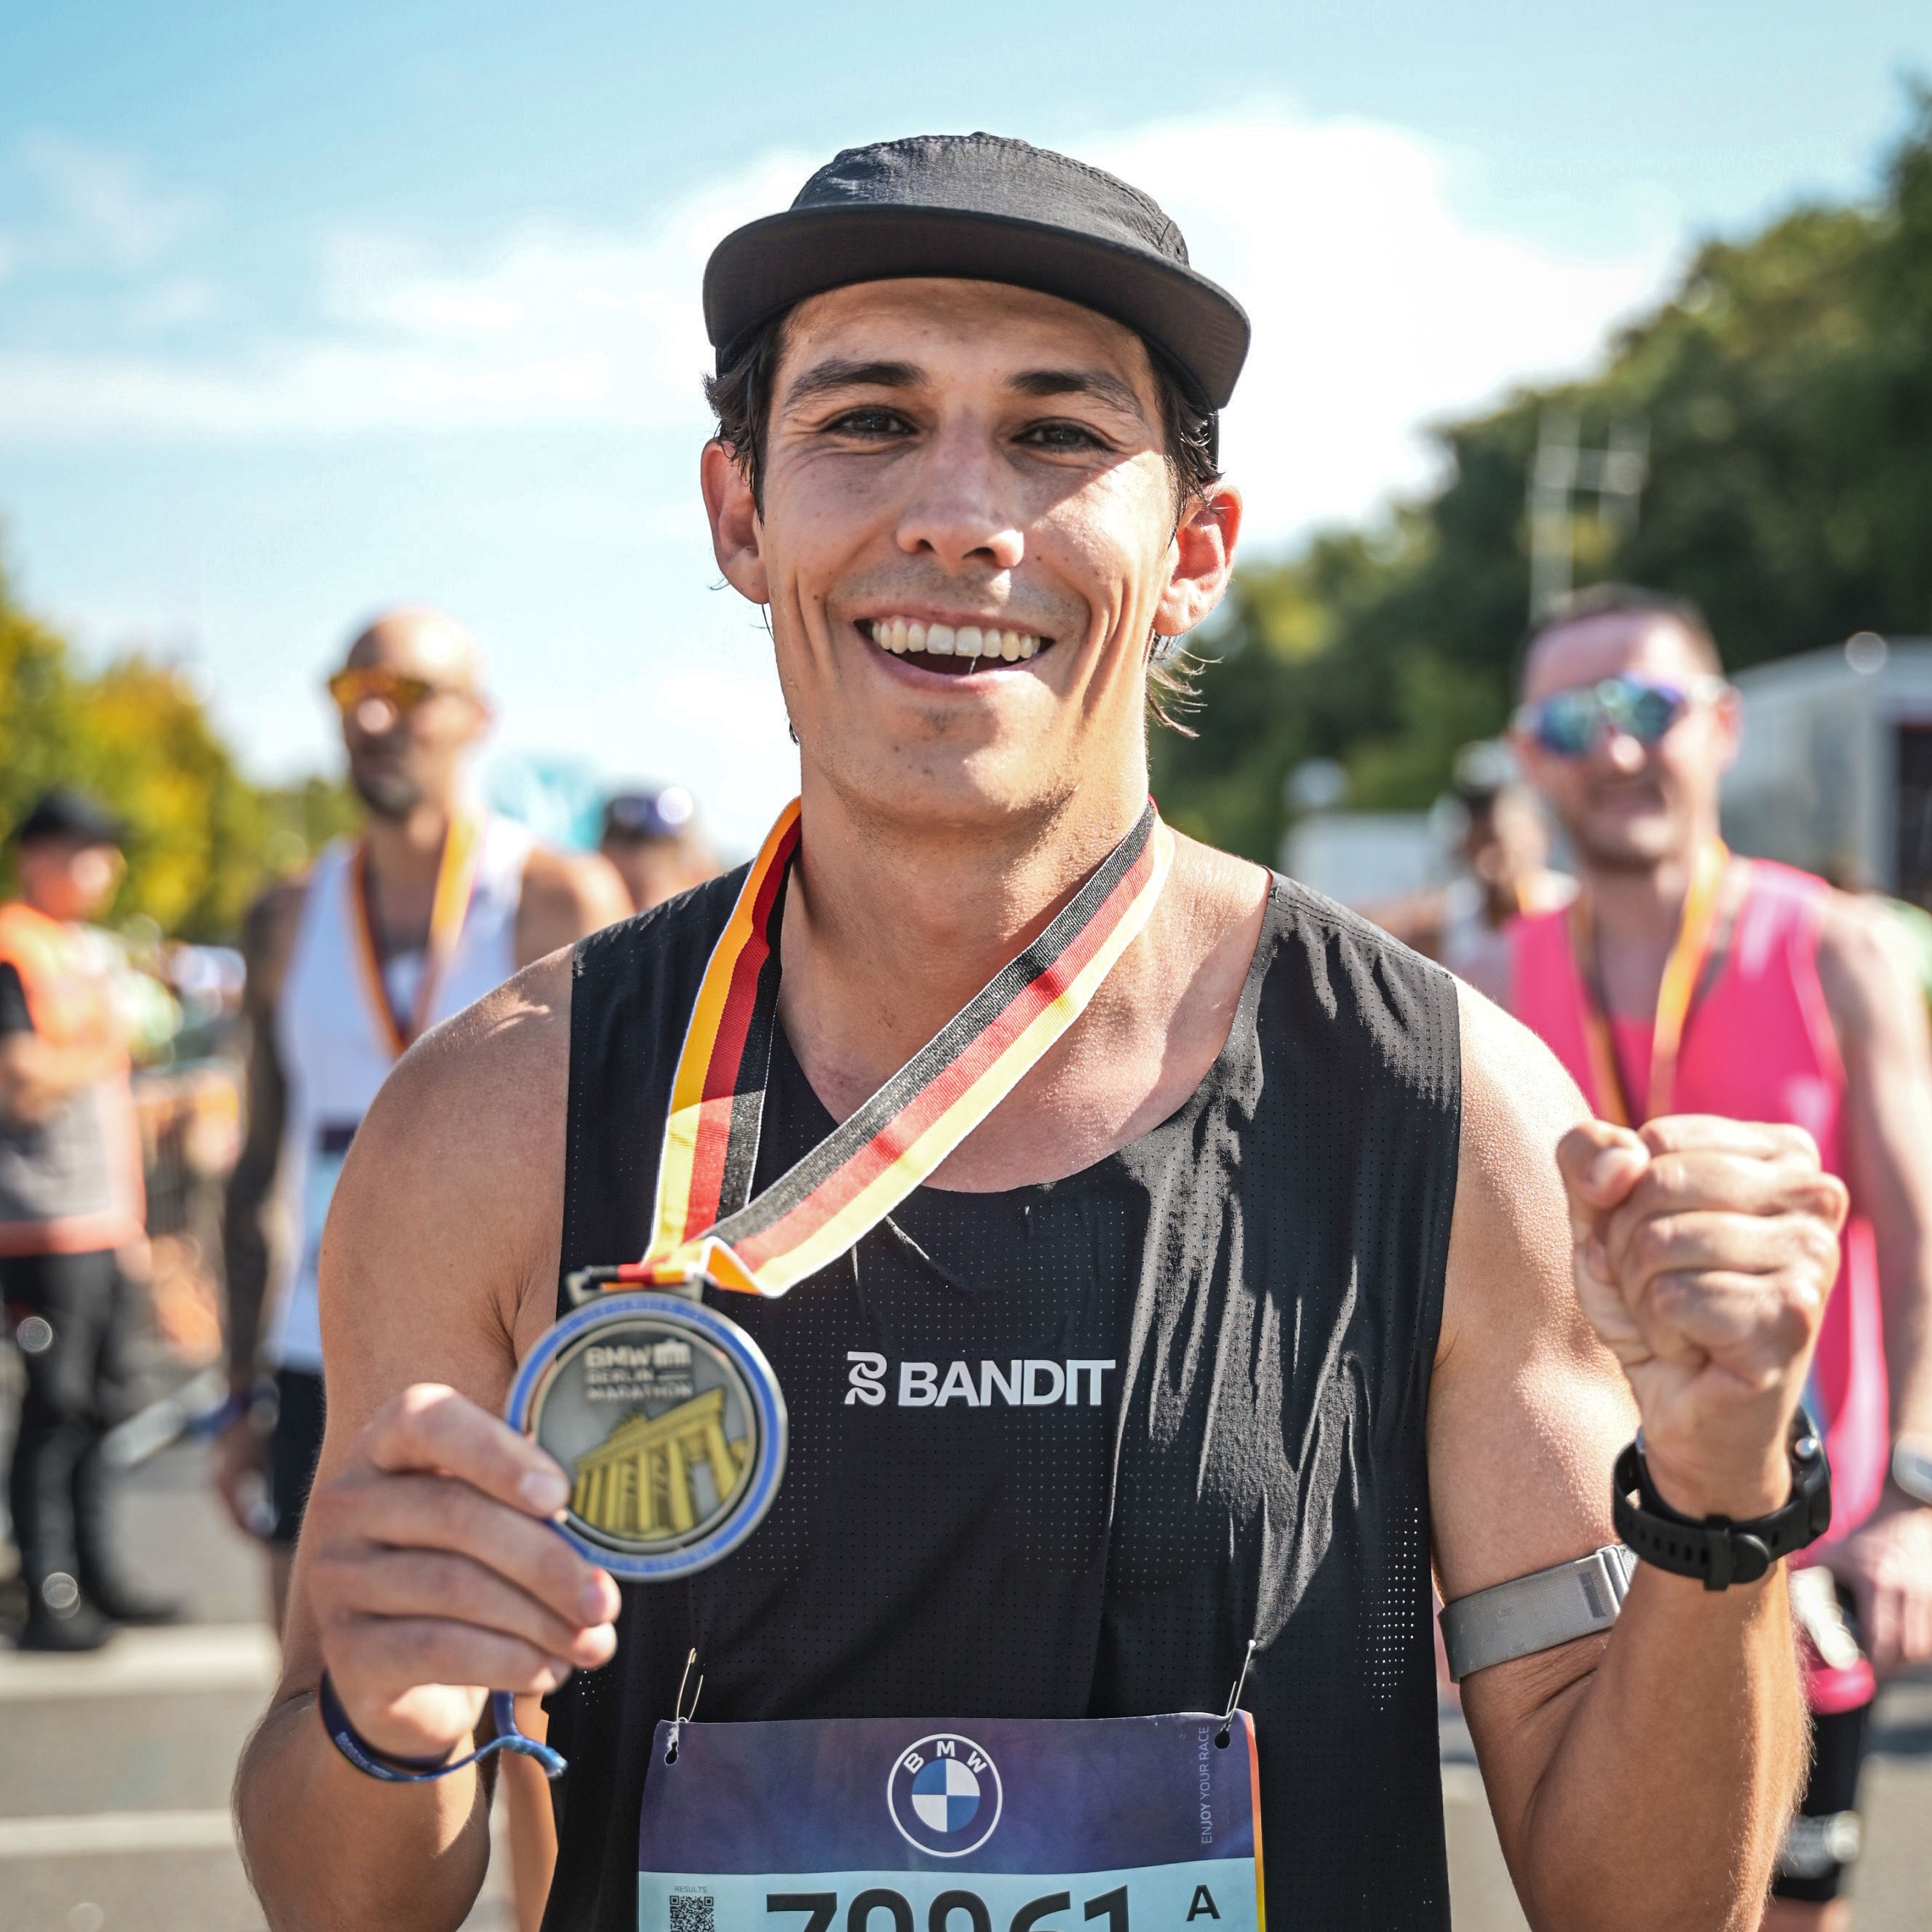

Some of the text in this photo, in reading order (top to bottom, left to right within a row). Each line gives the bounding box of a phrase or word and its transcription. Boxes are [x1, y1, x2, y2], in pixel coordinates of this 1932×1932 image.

[585, 1345, 652, 1367] BMW
[898, 1359, 1116, 1407] BANDIT
[903, 1740, 987, 1774] BMW
[1198, 1726, 1212, 1844] ENJOY YOUR RACE
[675, 1885, 707, 1893] RESULTS
[1186, 1884, 1221, 1922] A
